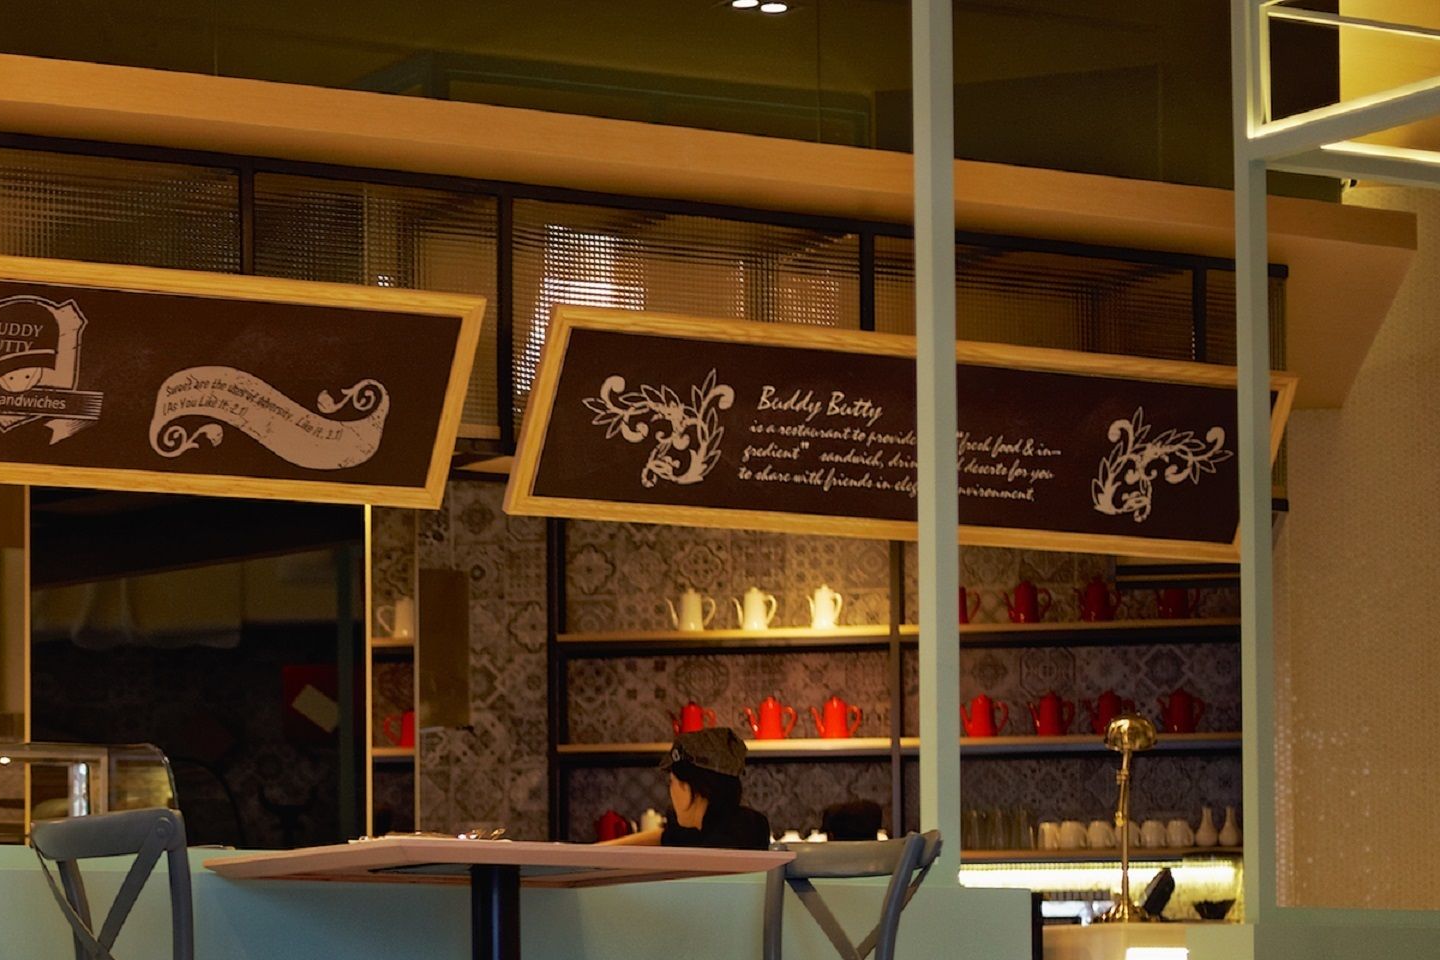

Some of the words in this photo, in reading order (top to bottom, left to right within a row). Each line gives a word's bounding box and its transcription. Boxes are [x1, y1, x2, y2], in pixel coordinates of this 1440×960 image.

[211, 378, 227, 391] the
[757, 385, 822, 422] Buddy
[827, 391, 883, 427] Butty
[750, 419, 764, 433] is
[766, 424, 775, 434] a
[778, 424, 851, 440] restaurant
[852, 427, 866, 442] to
[866, 430, 917, 447] provide
[991, 434, 1024, 458] food
[1022, 438, 1035, 456] &
[738, 466, 752, 480] to
[754, 464, 792, 483] share
[793, 467, 825, 485] with
[823, 467, 872, 492] friends
[876, 475, 891, 489] in
[1008, 458, 1028, 482] for
[1030, 468, 1056, 484] you
